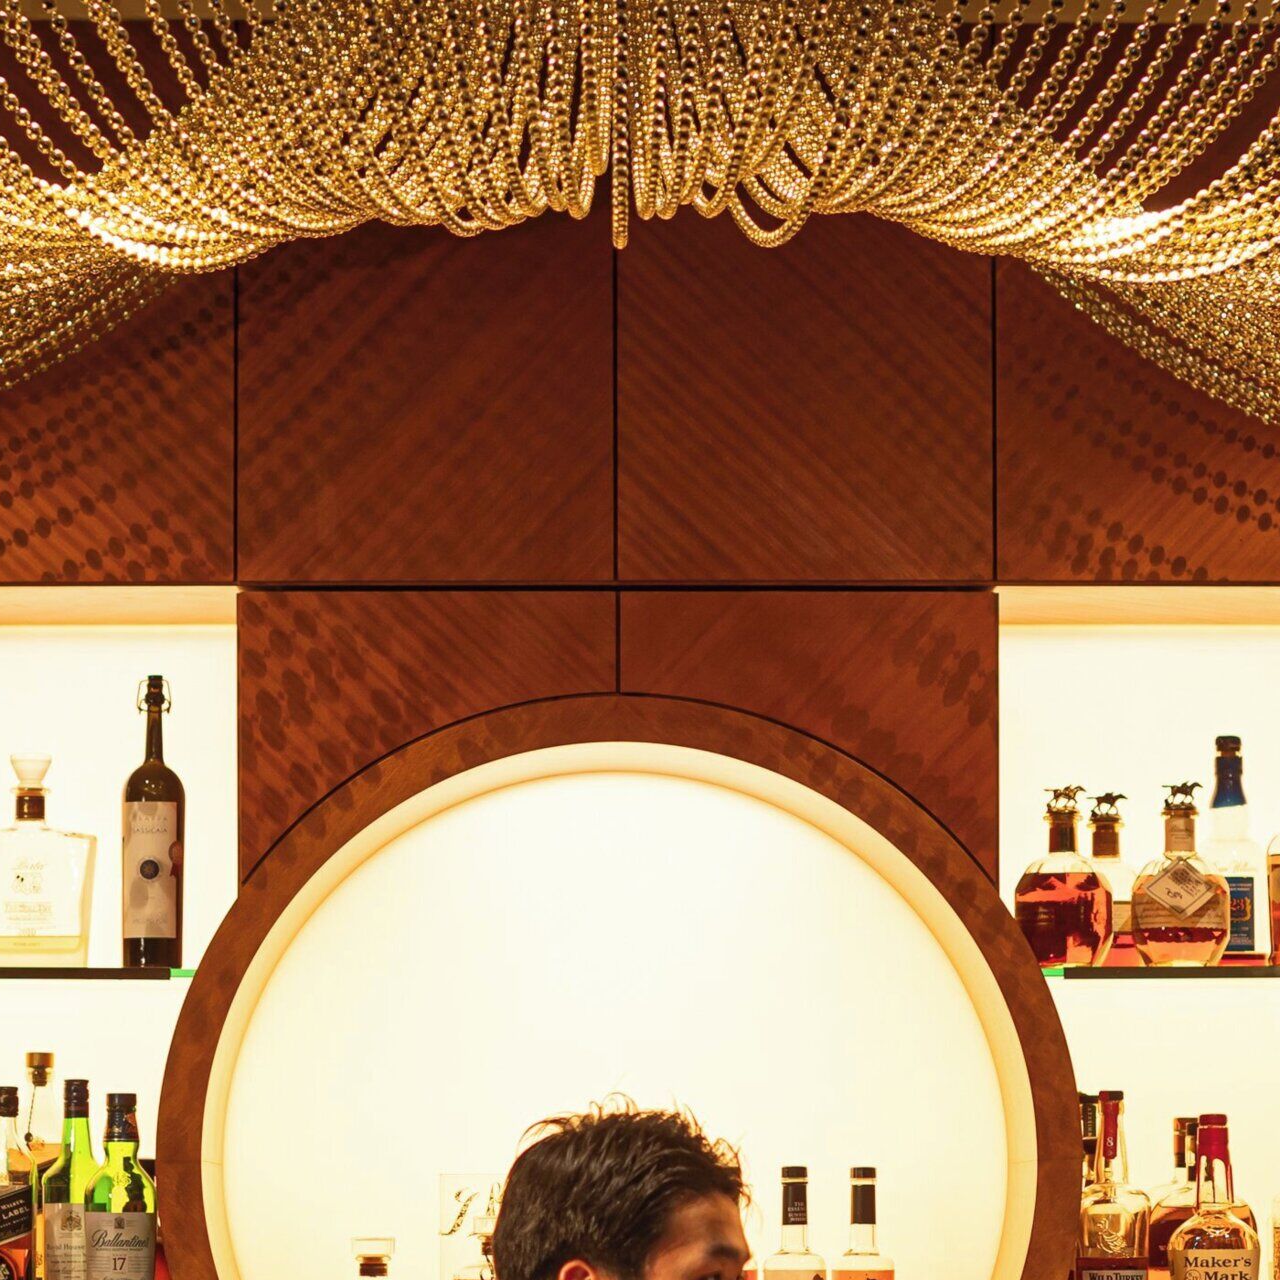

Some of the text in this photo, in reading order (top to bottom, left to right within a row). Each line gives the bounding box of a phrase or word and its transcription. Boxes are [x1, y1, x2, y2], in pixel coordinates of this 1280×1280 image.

[2, 1206, 30, 1221] LABEL
[112, 1257, 127, 1271] 17
[1183, 1257, 1252, 1268] Maker's
